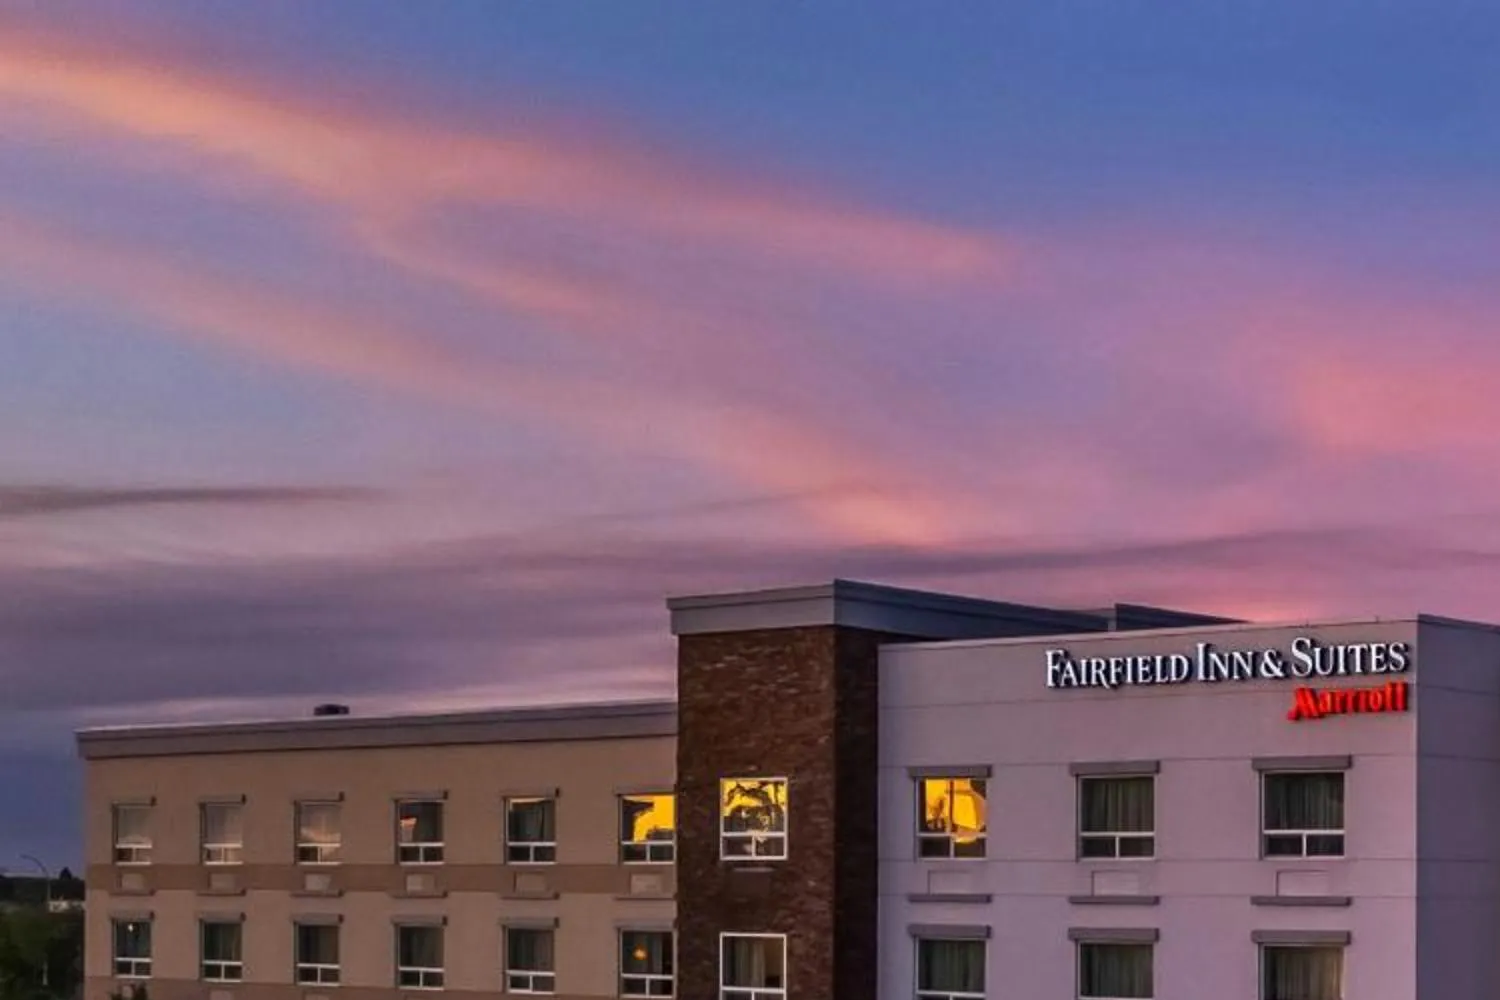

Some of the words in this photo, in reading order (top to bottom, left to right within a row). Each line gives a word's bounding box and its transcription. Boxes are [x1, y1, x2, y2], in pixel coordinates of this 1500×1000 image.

[1045, 648, 1192, 689] FAIRFIELD
[1197, 642, 1256, 682] INN
[1259, 648, 1284, 678] &
[1291, 636, 1410, 679] SUITES
[1286, 680, 1409, 722] Marriott
